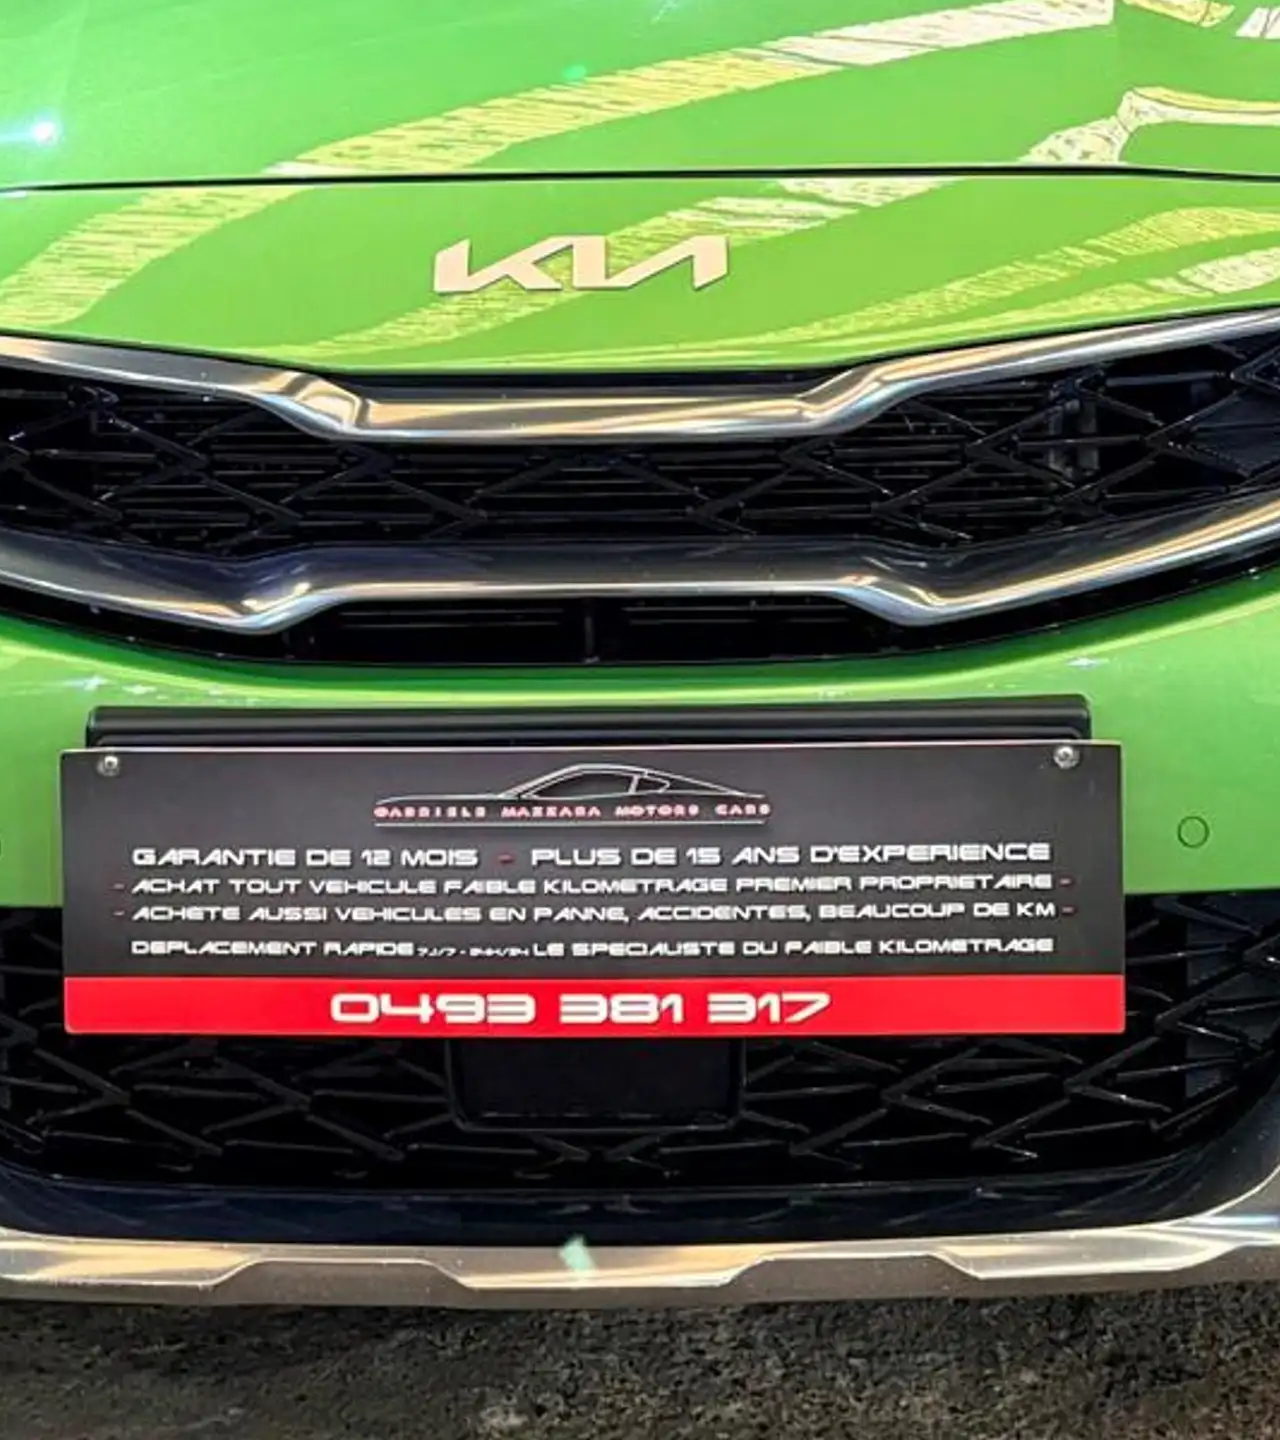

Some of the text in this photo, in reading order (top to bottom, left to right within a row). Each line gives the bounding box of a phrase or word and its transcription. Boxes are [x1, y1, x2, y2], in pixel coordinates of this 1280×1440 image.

[433, 234, 730, 293] KIA
[132, 847, 297, 867] GARANTIE
[305, 847, 352, 867] DE
[360, 847, 392, 867] 12
[400, 847, 479, 867] MOIS
[530, 847, 622, 867] PLUS
[630, 846, 677, 866] DE
[685, 845, 722, 865] 15
[730, 844, 800, 865] ANS
[809, 841, 1051, 863] D'EXPERIENCE
[131, 877, 222, 895] ACHAT
[228, 877, 302, 895] TOUT
[308, 877, 438, 895] VEHICULE
[443, 878, 537, 895] FAIBLE
[543, 876, 728, 895] KILOMETRAGE
[735, 874, 853, 893] PREMIER
[859, 872, 1053, 891] PROPRIETAIRE
[131, 905, 241, 922] ACHETE
[248, 905, 328, 922] AUSSI
[334, 905, 482, 923] VEHICULES
[488, 905, 527, 923] EN
[818, 901, 966, 920] BEAUCOUP
[973, 901, 1010, 919] DE
[1016, 901, 1056, 918] KM
[131, 939, 318, 957] DEPLACEMENT
[323, 940, 414, 957] RAPIDE
[532, 942, 565, 958] LE
[571, 940, 735, 958] SPECIALISTE
[742, 939, 779, 956] DU
[784, 939, 872, 956] FAIBLE
[878, 937, 1055, 955] KILOMETRAGE
[330, 991, 830, 1025] 0493 381 317
